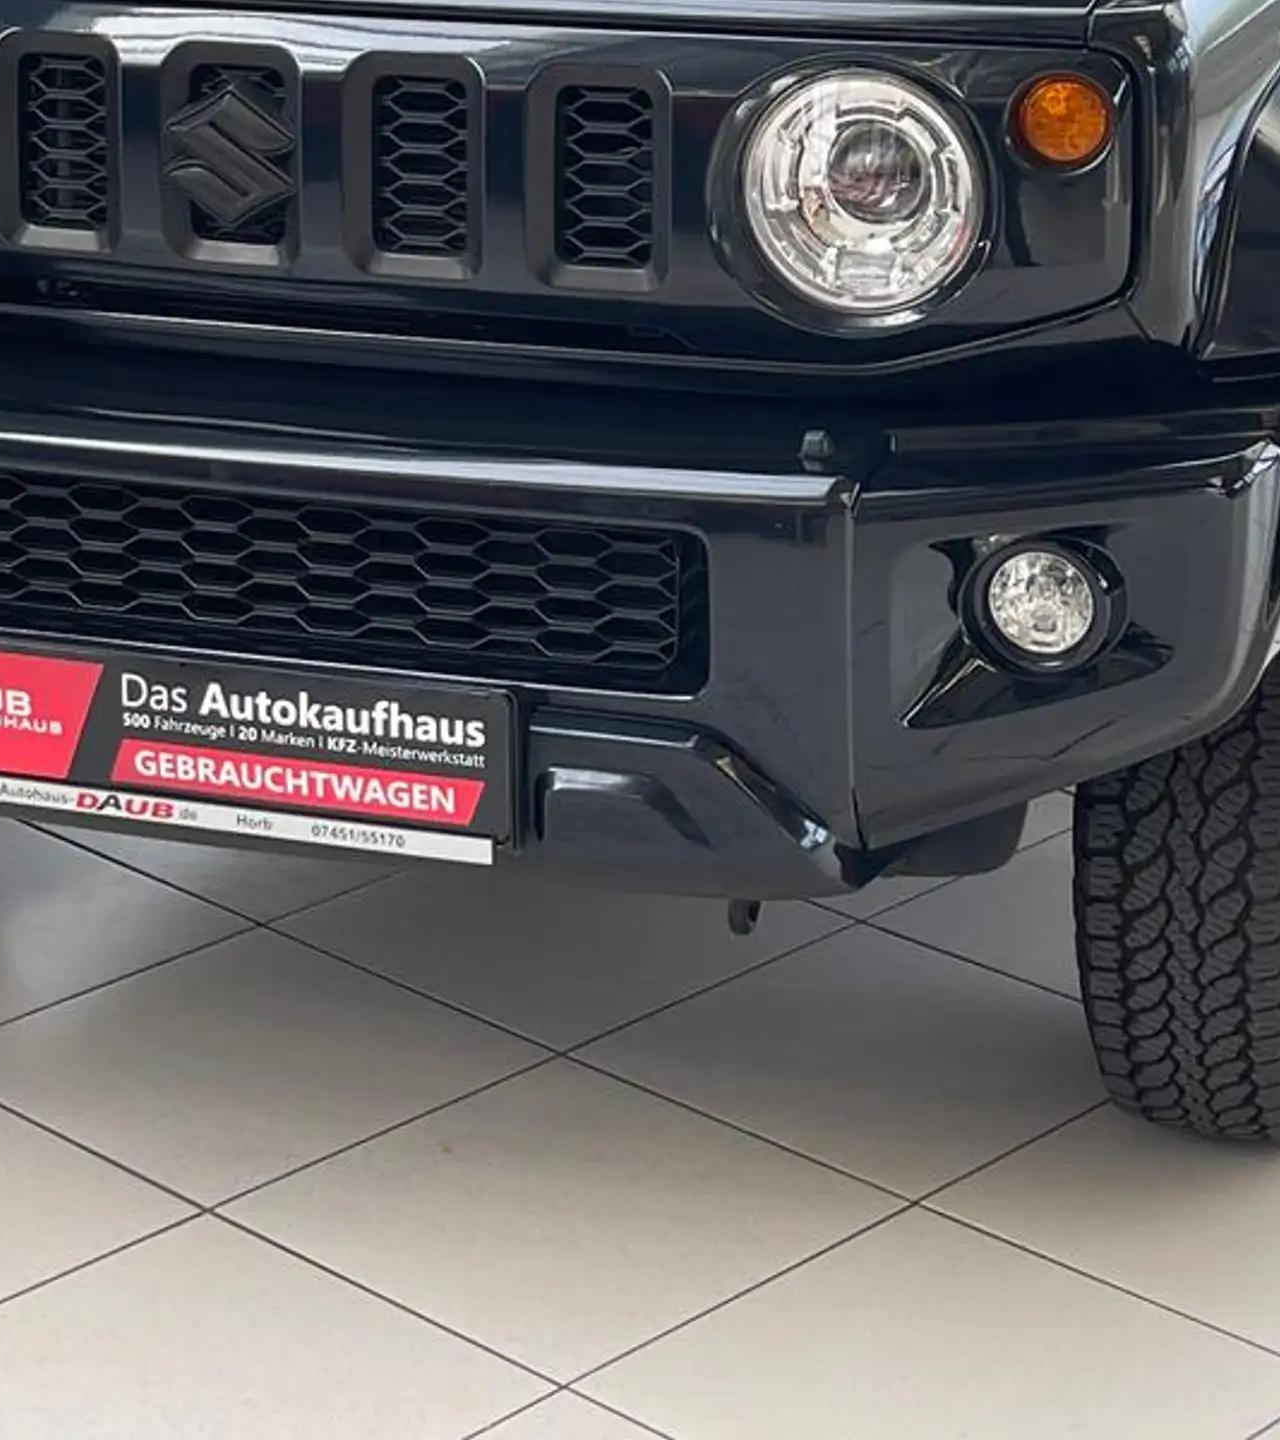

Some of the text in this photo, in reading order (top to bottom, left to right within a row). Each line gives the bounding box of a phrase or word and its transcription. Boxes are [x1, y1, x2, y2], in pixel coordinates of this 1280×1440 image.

[121, 672, 486, 748] Das Autokaufhaus
[123, 712, 151, 729] 500
[154, 715, 227, 741] Fahrzeuge
[238, 724, 258, 742] 20
[261, 729, 315, 748] Marken
[327, 736, 486, 769] KFZ-Meisterwerkstatt
[134, 750, 456, 814] GEBRAUCHTWAGEN
